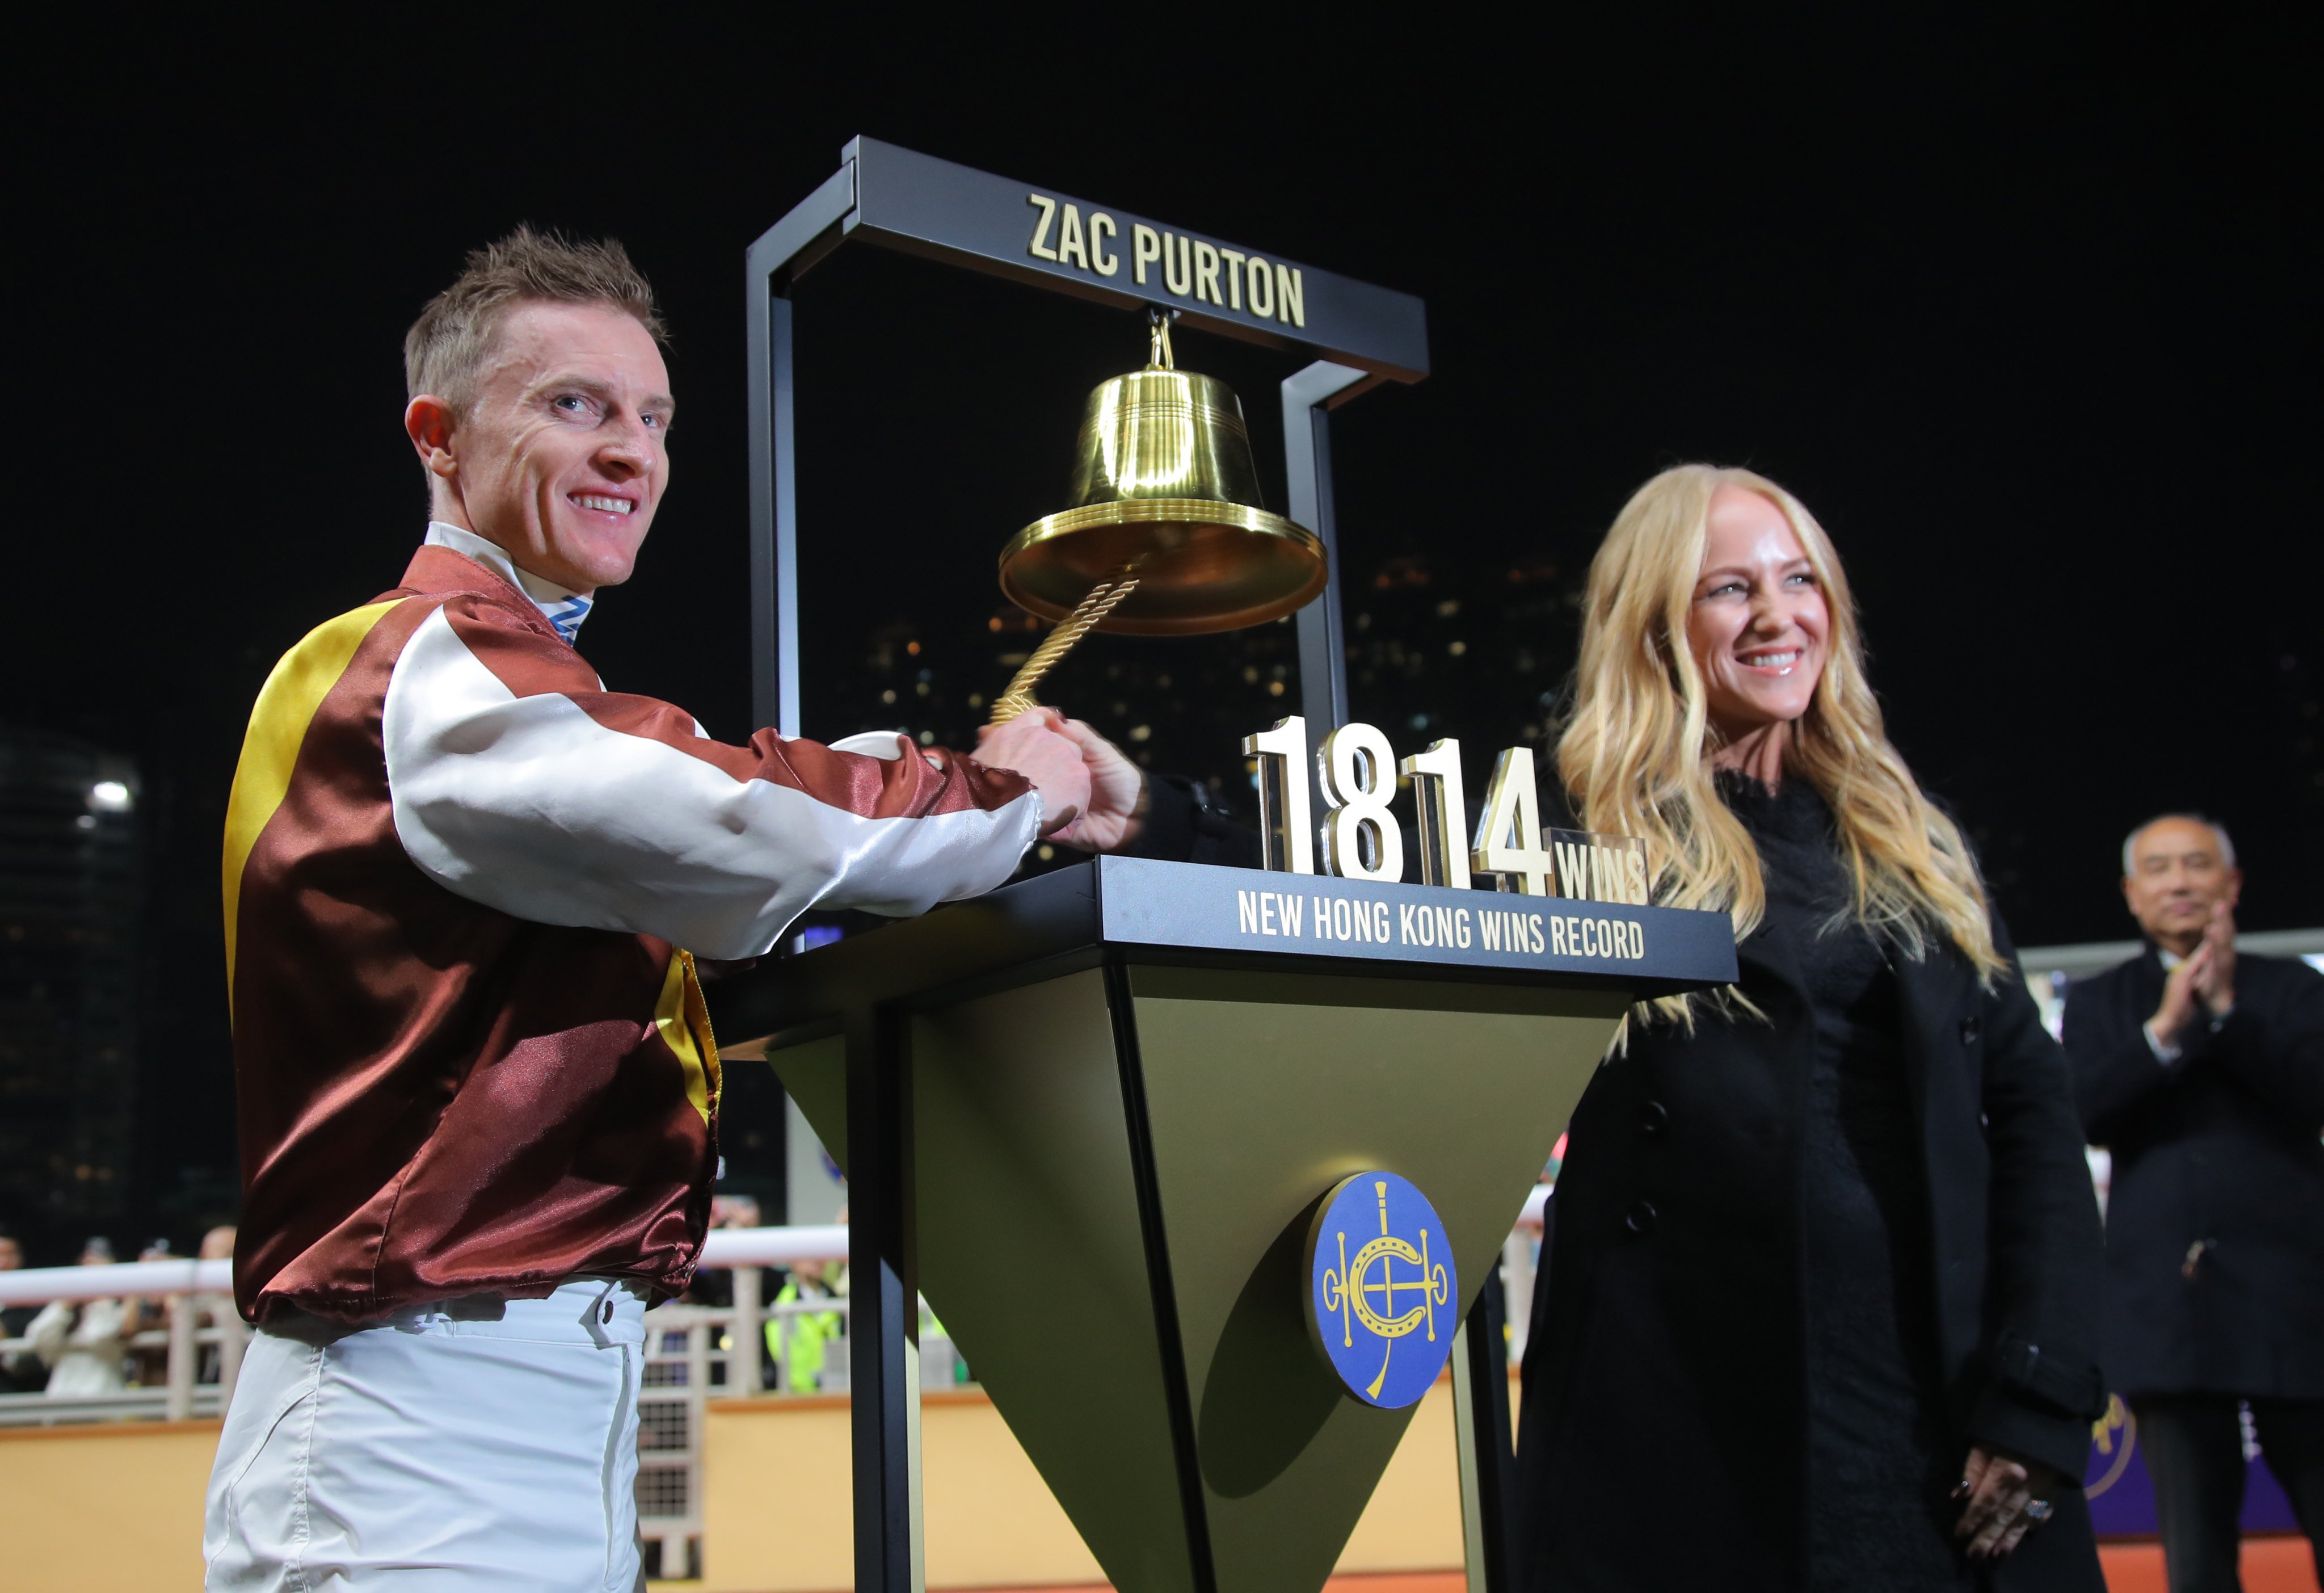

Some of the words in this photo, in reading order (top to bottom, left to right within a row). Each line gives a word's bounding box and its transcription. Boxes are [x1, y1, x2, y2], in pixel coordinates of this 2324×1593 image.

[1029, 194, 1118, 276] ZAC
[1132, 223, 1306, 327] PURTON
[1243, 715, 1552, 896] 1814
[1556, 842, 1648, 905] WINS
[1238, 890, 1303, 937] NEW
[1313, 897, 1390, 944] HONG
[1400, 905, 1471, 949] KONG
[1479, 911, 1545, 954] WINS
[1551, 917, 1644, 960] RECORD
